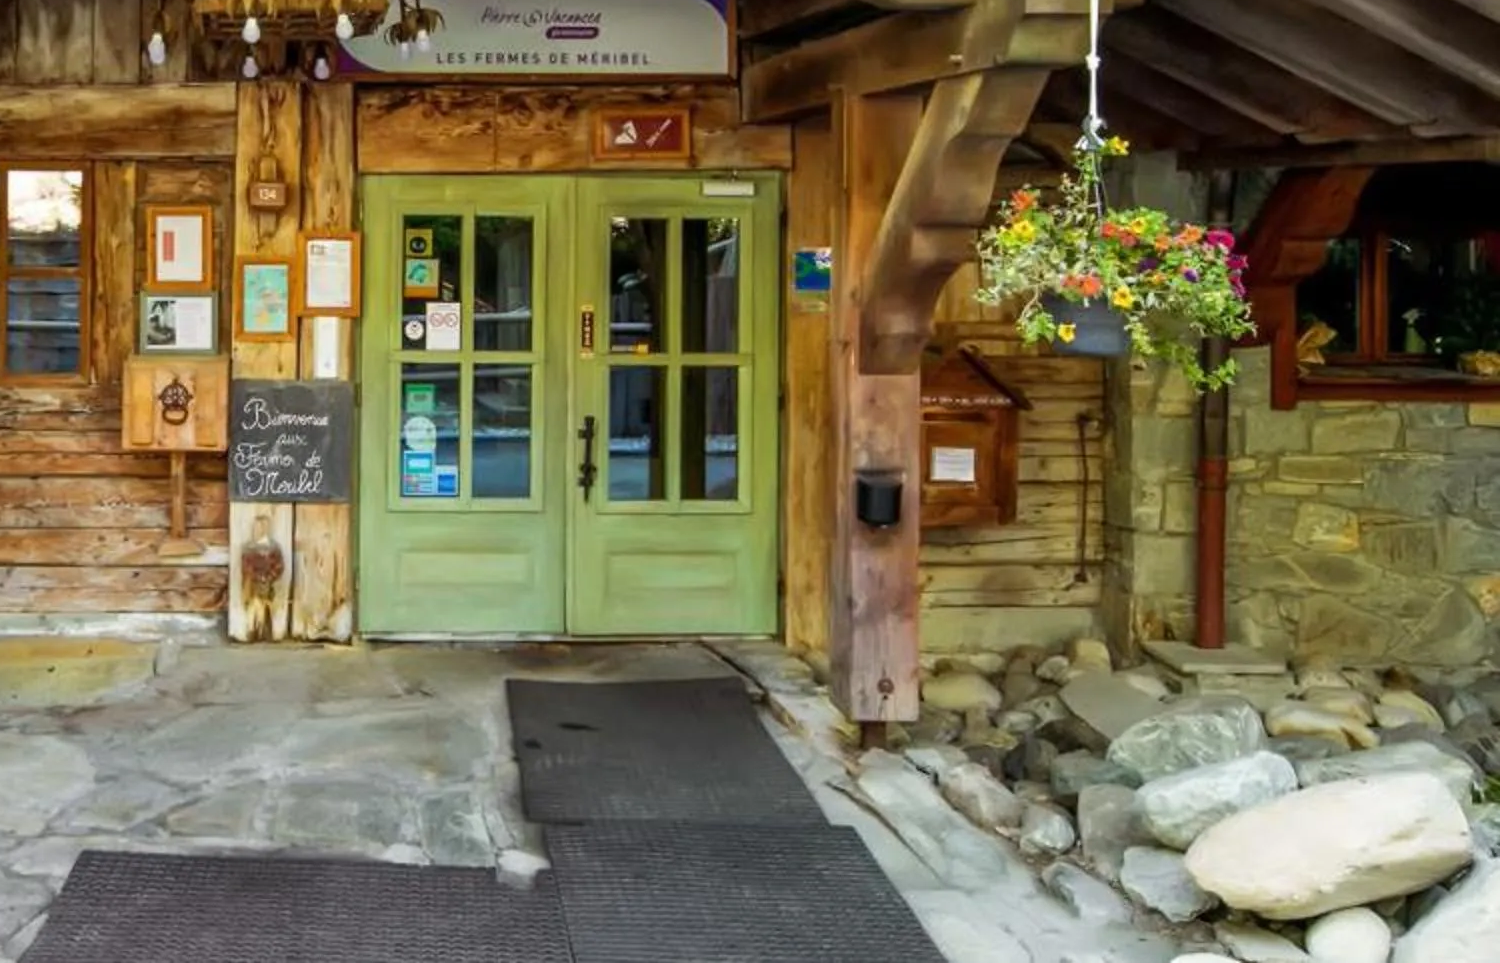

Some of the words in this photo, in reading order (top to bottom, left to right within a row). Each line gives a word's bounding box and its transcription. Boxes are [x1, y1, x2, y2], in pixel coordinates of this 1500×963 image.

[481, 6, 521, 24] Pierre
[545, 8, 602, 24] Vacances
[435, 52, 467, 65] LES
[474, 52, 541, 65] FERMES
[549, 52, 569, 65] DE
[577, 49, 649, 65] MÉRIBEL
